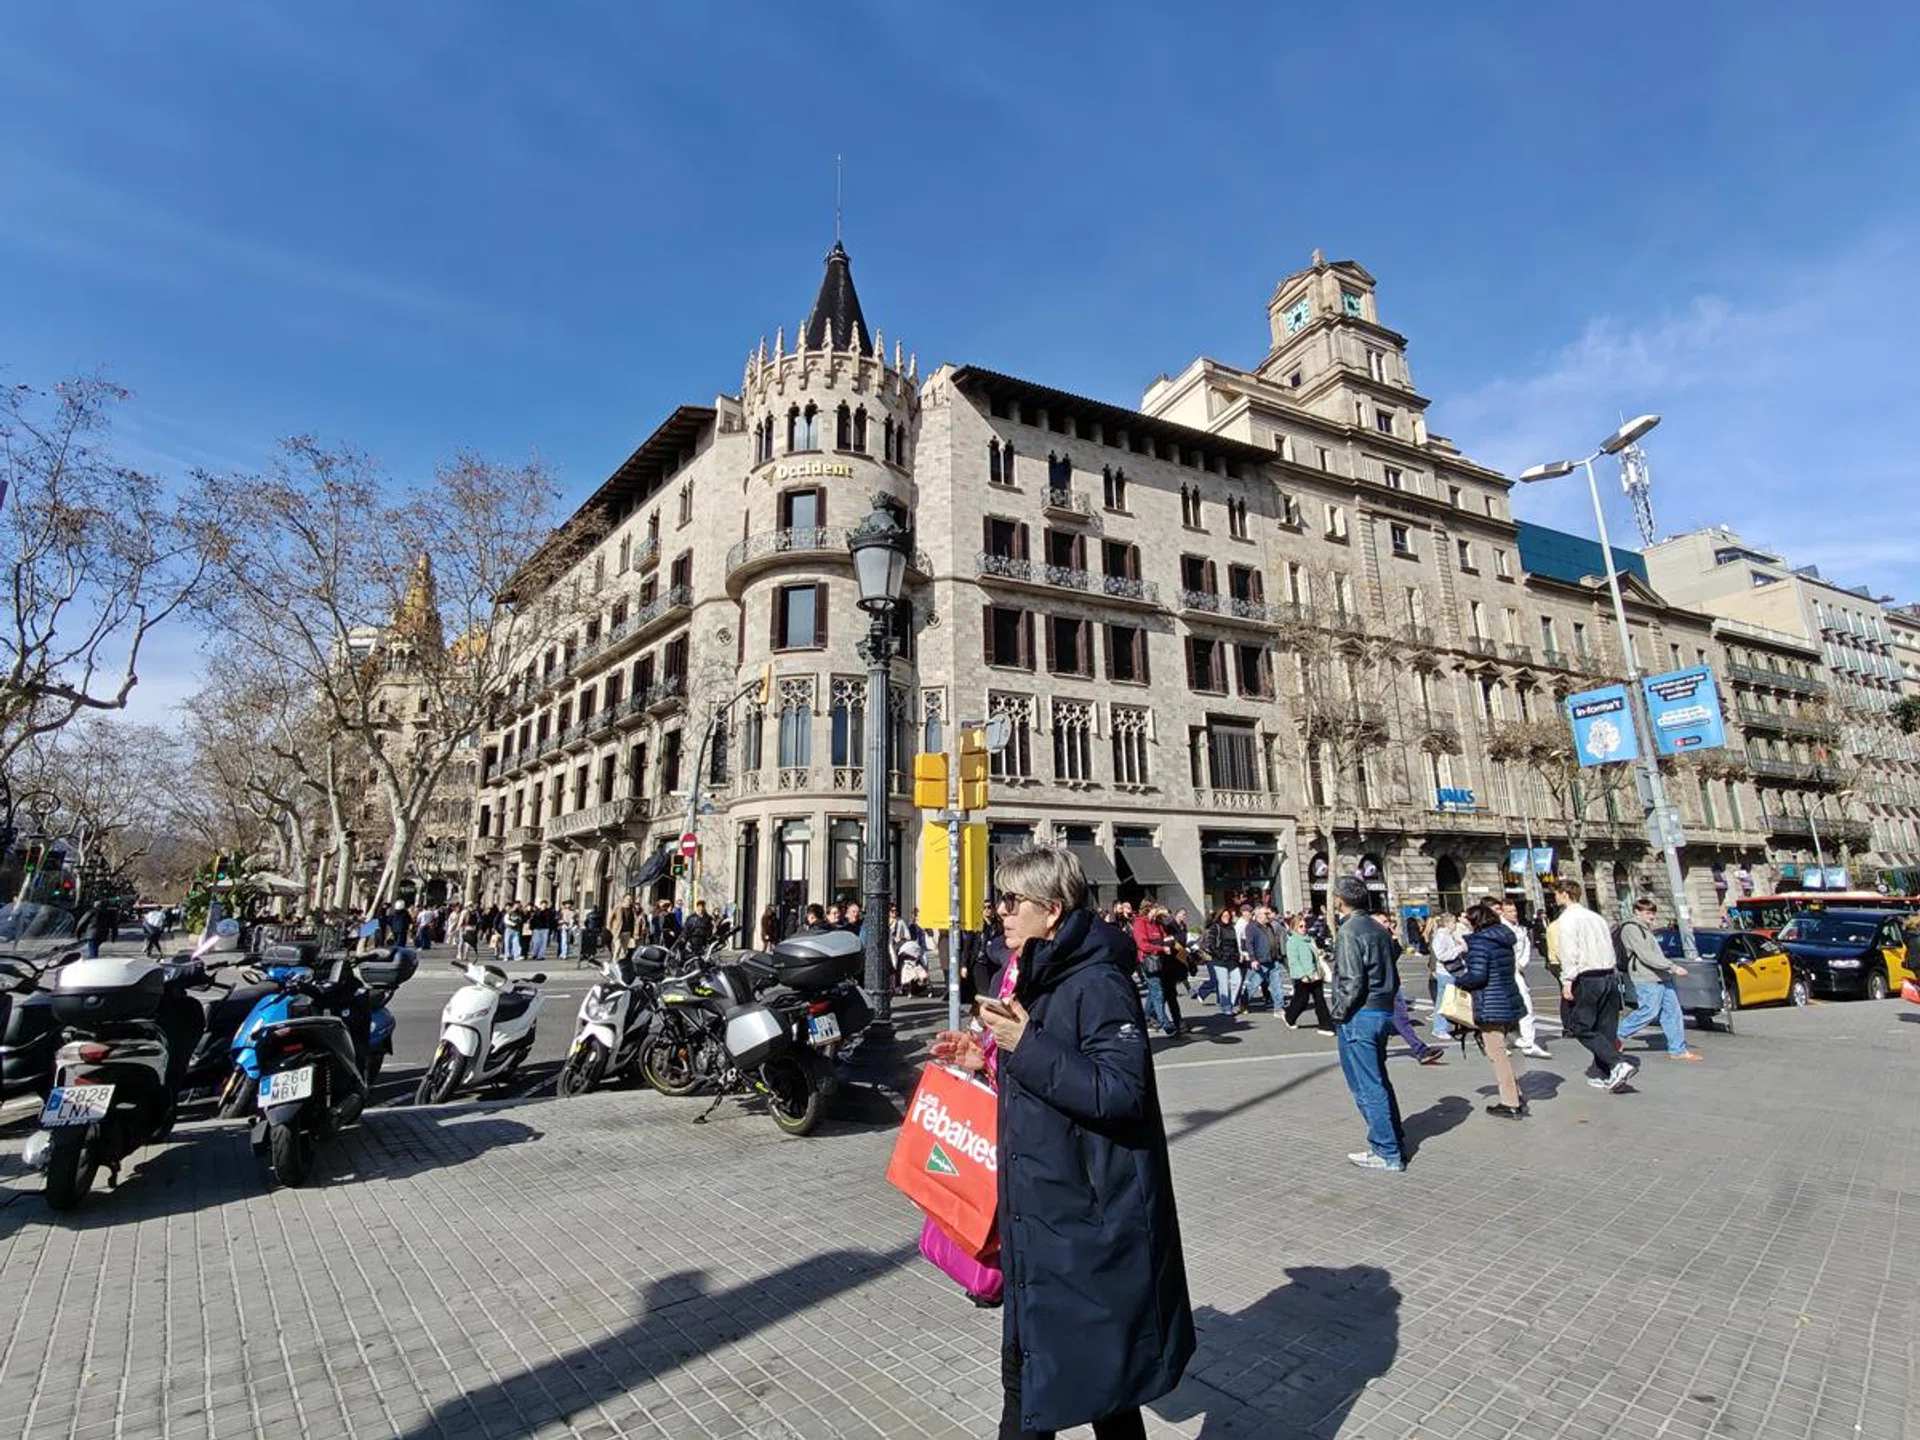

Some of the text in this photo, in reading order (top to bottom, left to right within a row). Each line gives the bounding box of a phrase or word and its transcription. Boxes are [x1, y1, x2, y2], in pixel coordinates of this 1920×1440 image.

[777, 461, 853, 480] Occident
[272, 1070, 309, 1087] 4260
[64, 1088, 110, 1103] 2828
[58, 1103, 92, 1119] LNX
[912, 1101, 997, 1171] rebaixes
